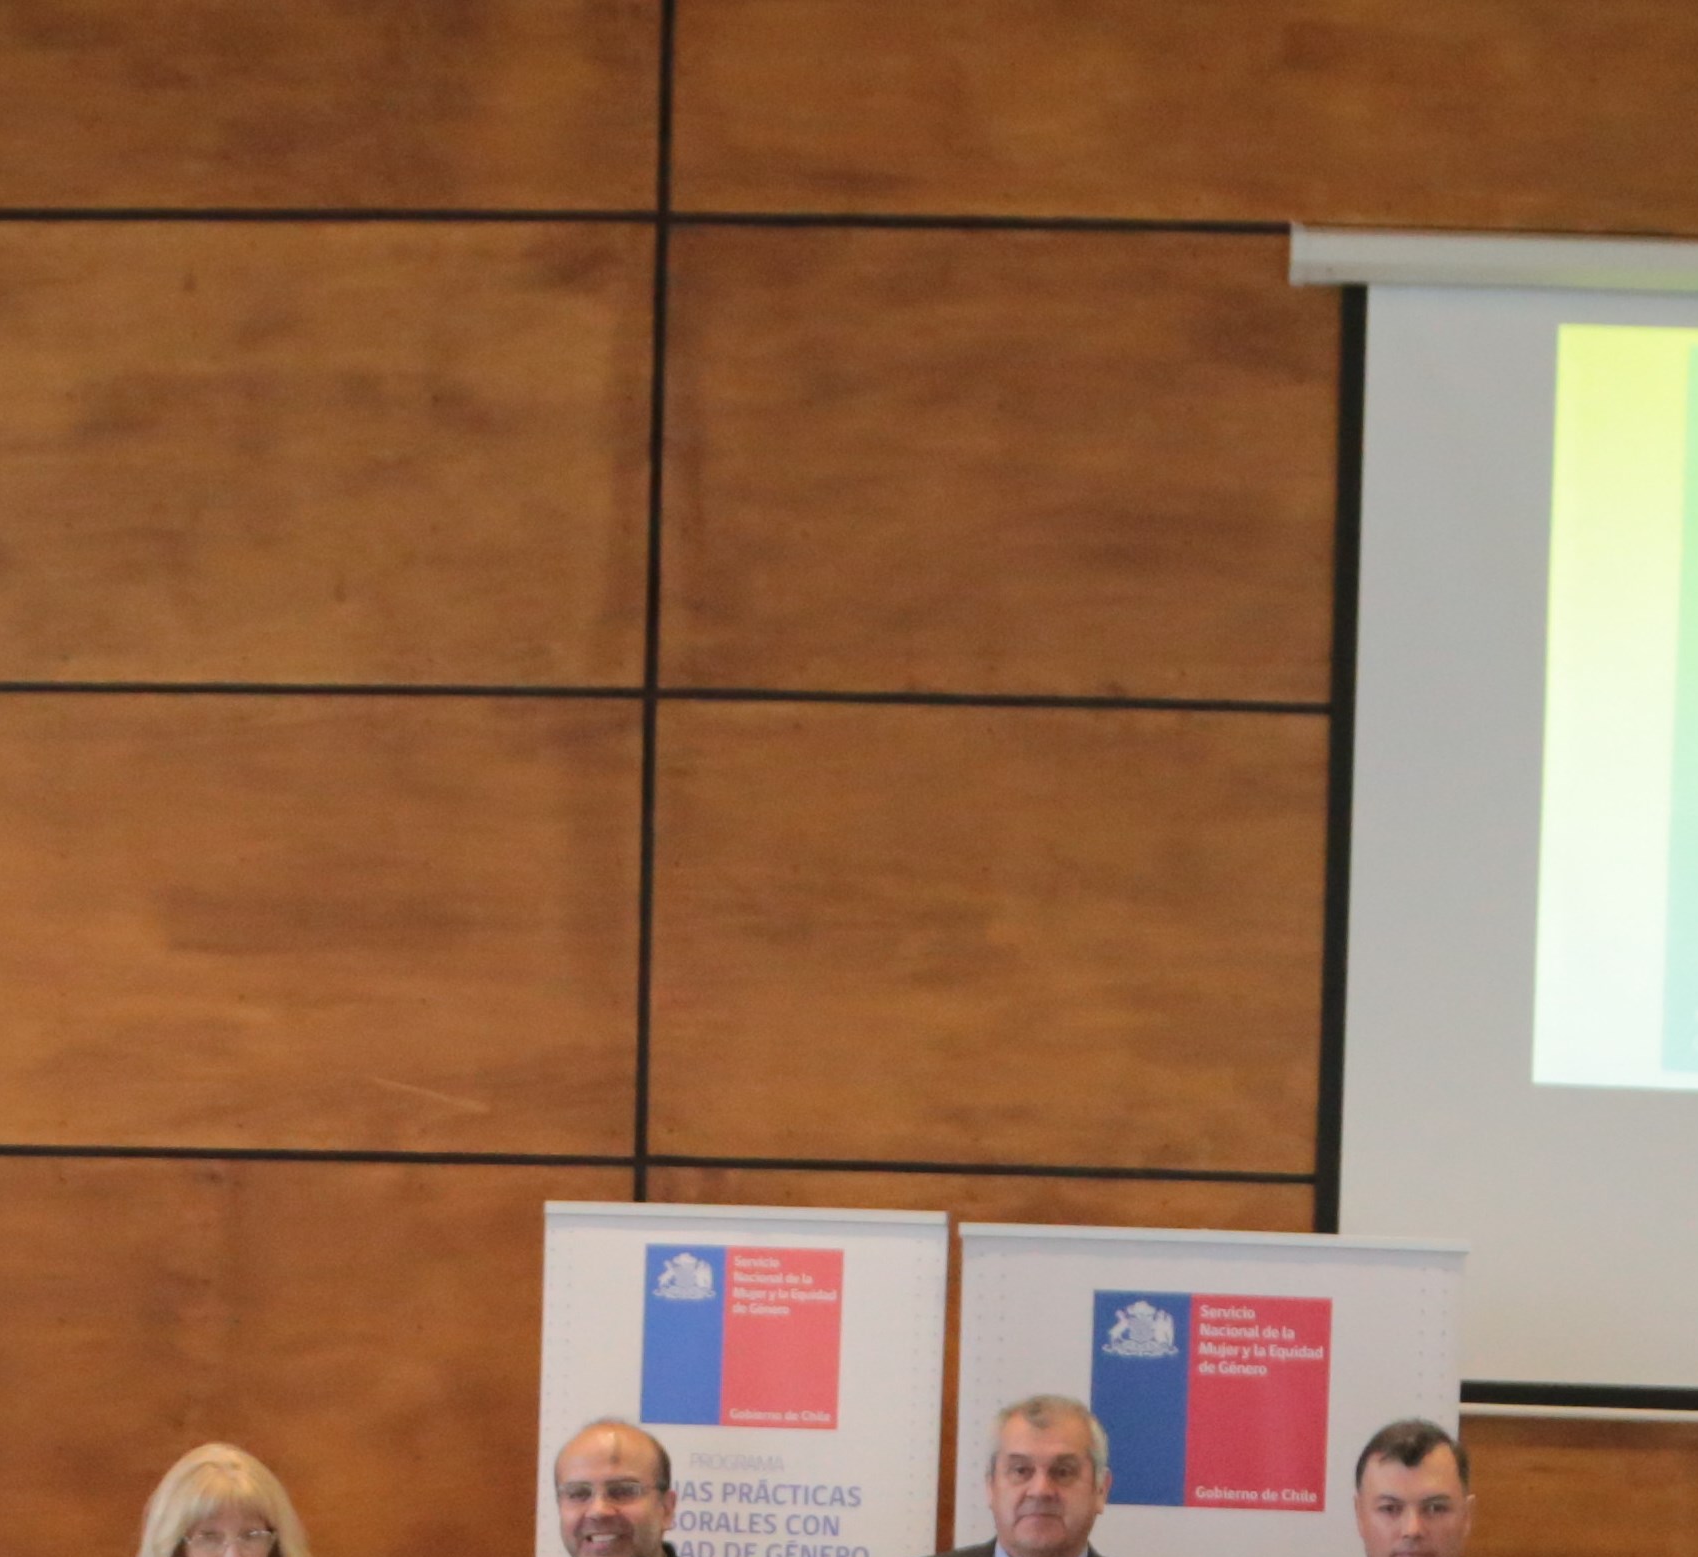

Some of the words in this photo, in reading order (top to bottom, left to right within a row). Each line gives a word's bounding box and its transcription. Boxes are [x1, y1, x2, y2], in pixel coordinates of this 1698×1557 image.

[734, 1256, 780, 1268] Servicio
[733, 1271, 783, 1284] Nacional
[785, 1273, 801, 1284] de
[802, 1272, 814, 1285] la
[732, 1287, 768, 1301] Mujer
[790, 1288, 837, 1303] Equidad
[731, 1303, 747, 1314] de
[1200, 1305, 1256, 1319] Servicio
[1199, 1322, 1259, 1338] Nacional
[1263, 1324, 1281, 1338] de
[1282, 1324, 1296, 1339] la
[1198, 1341, 1240, 1358] Mujer
[1241, 1346, 1252, 1359] y
[1253, 1344, 1267, 1358] la
[1269, 1344, 1324, 1361] Equidad
[1198, 1361, 1216, 1374] de
[1218, 1360, 1268, 1375] Género
[729, 1408, 783, 1420] Gobierno
[784, 1409, 800, 1421] de
[801, 1409, 831, 1422] Chile
[689, 1453, 785, 1472] PROGRAMA
[721, 1479, 863, 1508] PRÁCTICAS
[1195, 1485, 1258, 1500] Gobierno
[1261, 1487, 1278, 1500] de
[1281, 1488, 1318, 1503] Chile
[785, 1513, 840, 1537] CON
